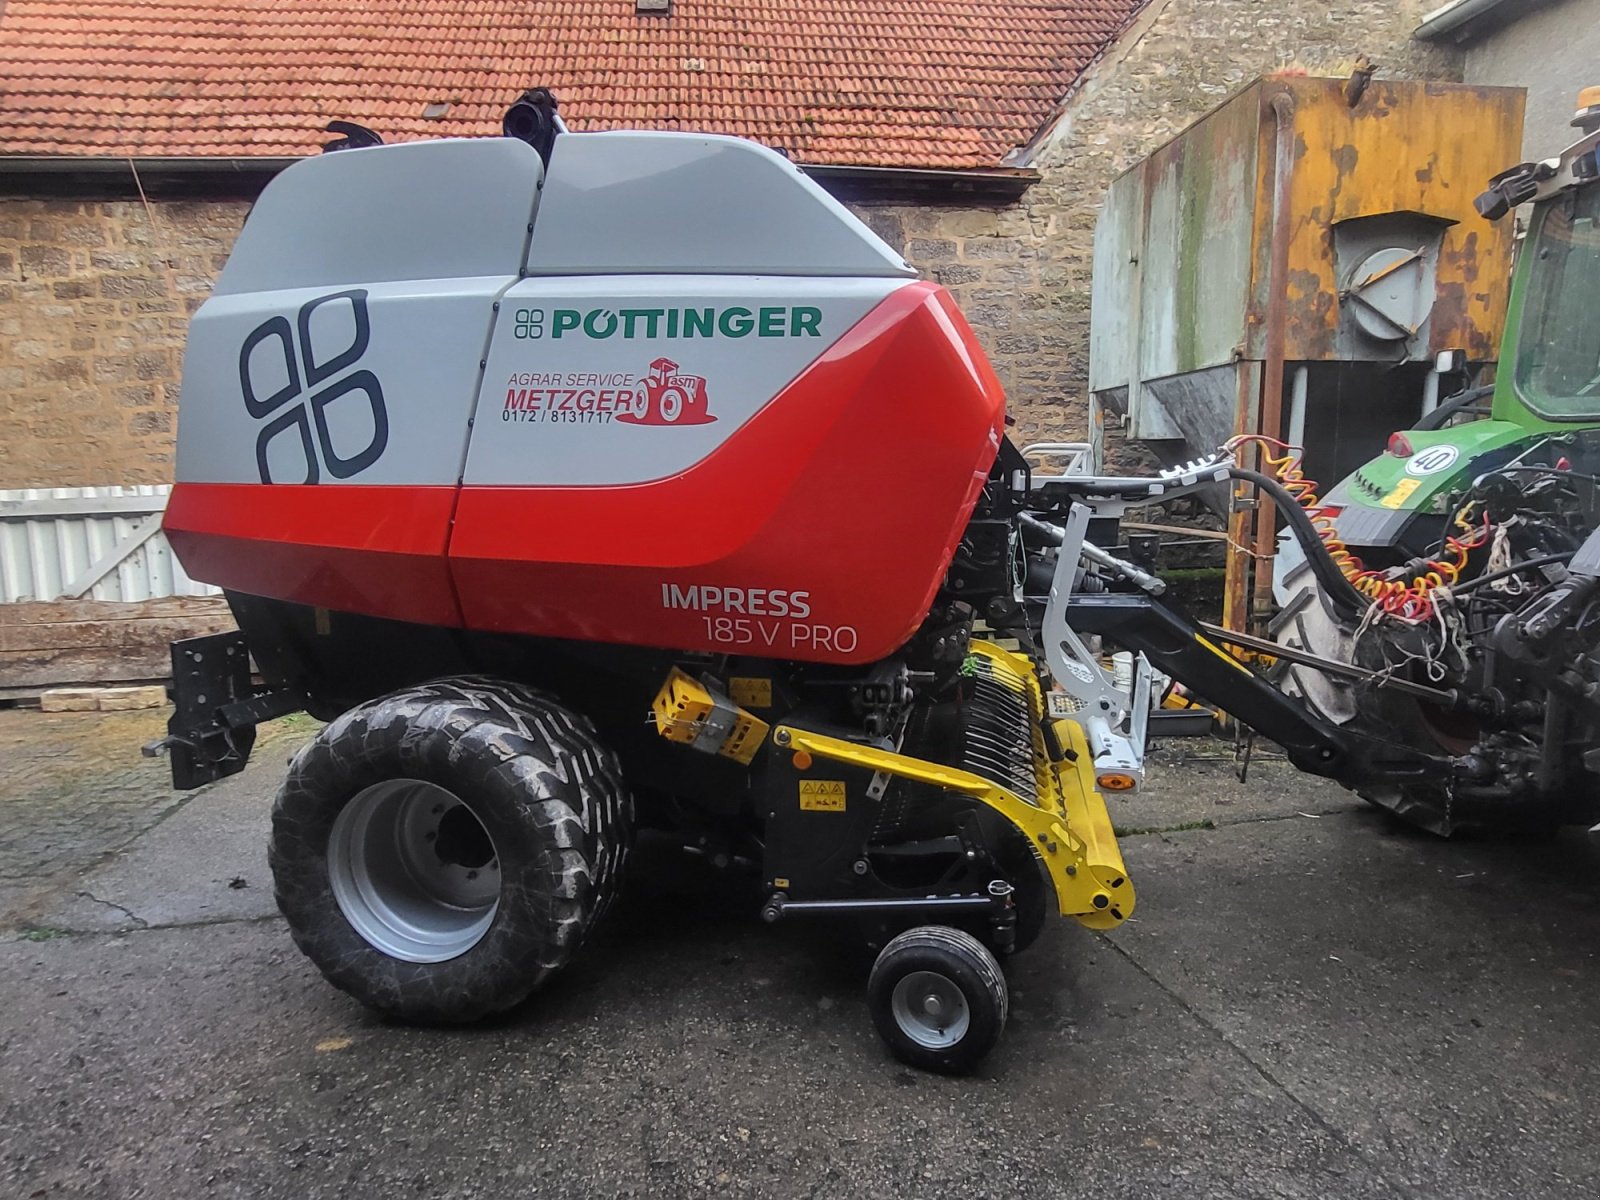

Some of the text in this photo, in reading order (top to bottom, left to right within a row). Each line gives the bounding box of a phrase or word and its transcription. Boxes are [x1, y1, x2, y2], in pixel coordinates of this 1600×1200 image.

[551, 306, 823, 339] PÖTTINGER
[507, 373, 634, 387] AGRAR SERVICE
[670, 377, 696, 389] asm
[504, 389, 634, 411] METZGER
[502, 409, 613, 424] 0172 / 8131717
[1414, 450, 1451, 470] 40
[661, 583, 811, 618] IMPRESS
[702, 616, 858, 653] 185 V PRO
